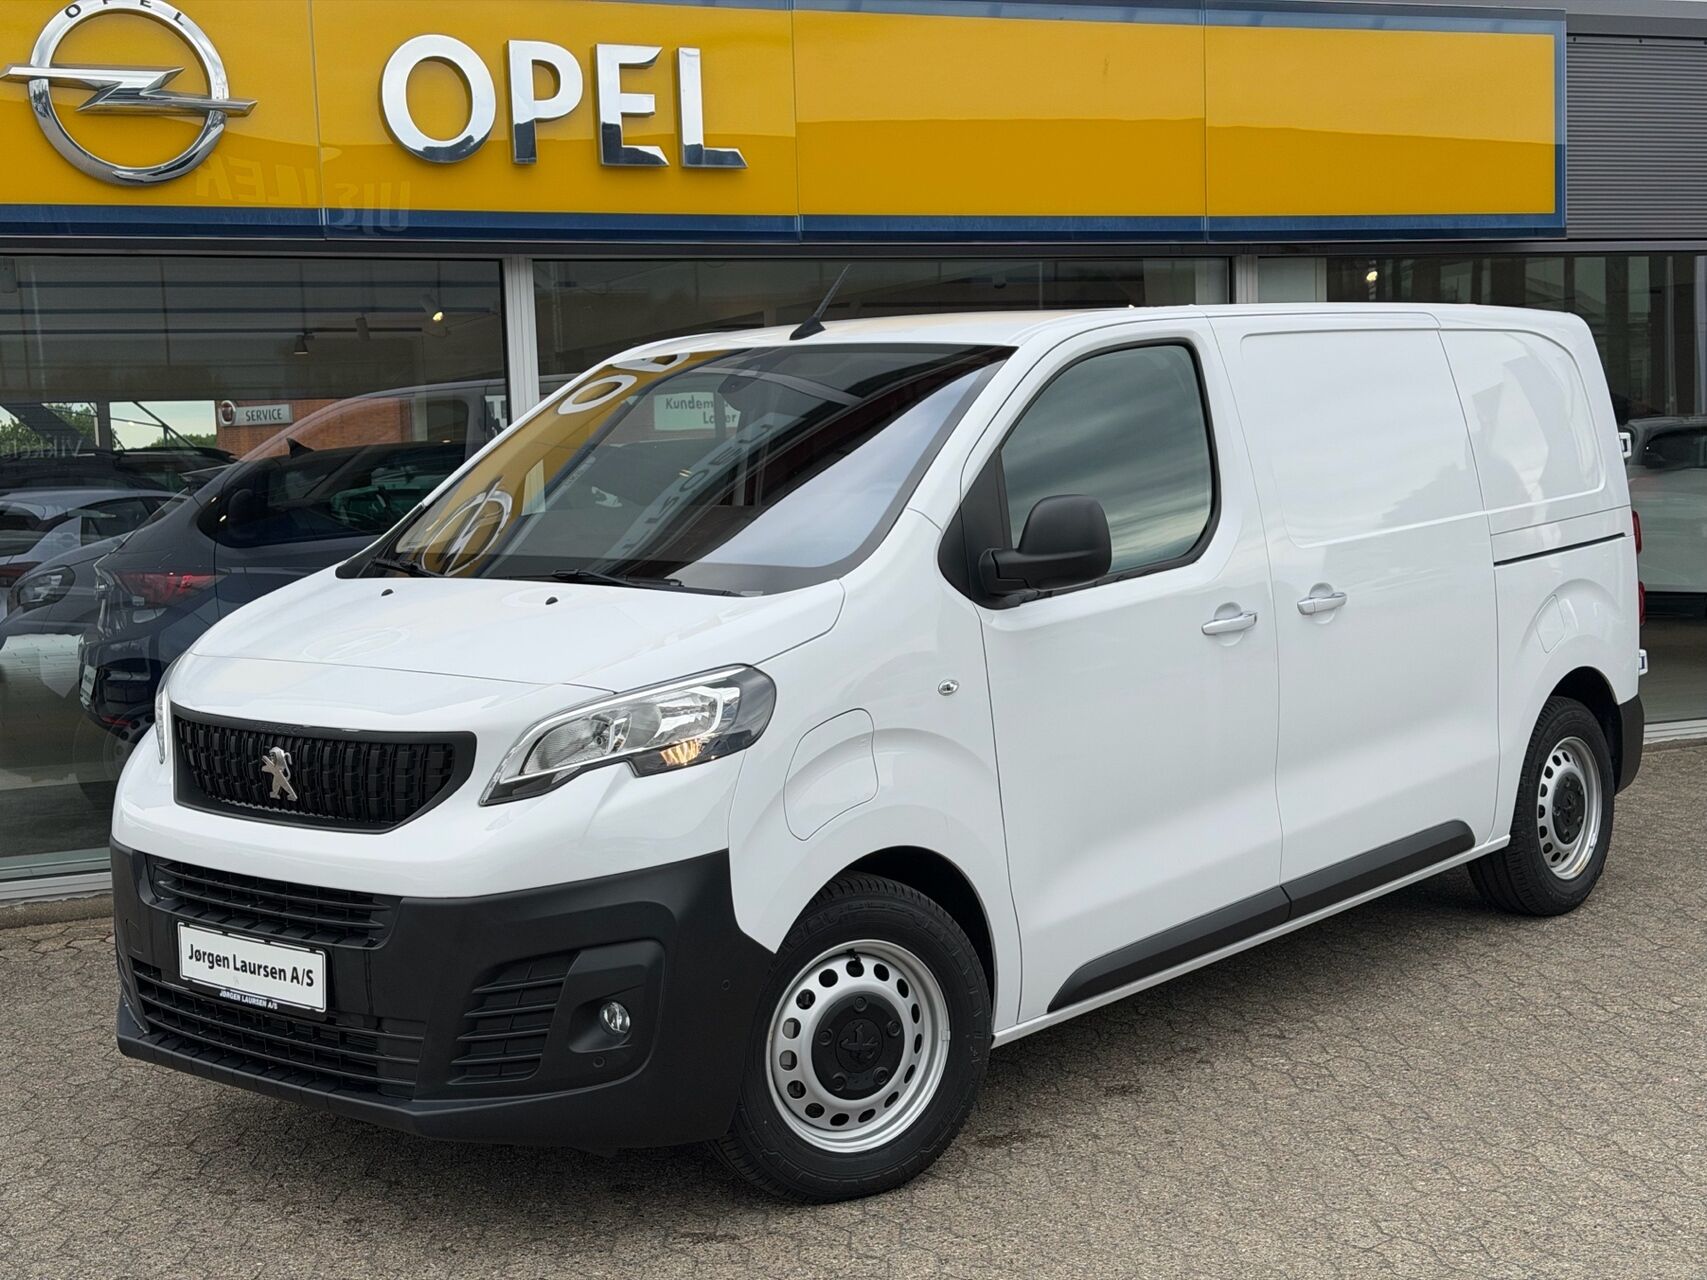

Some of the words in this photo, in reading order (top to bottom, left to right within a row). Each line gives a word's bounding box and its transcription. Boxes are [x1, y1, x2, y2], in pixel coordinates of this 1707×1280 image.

[379, 33, 748, 169] OPEL
[245, 408, 283, 422] SERVICE
[188, 943, 230, 970] Jørgen
[232, 953, 287, 982] Laursen
[290, 966, 314, 987] A/S
[241, 995, 267, 1008] LAURSEN
[267, 1001, 278, 1010] A/S
